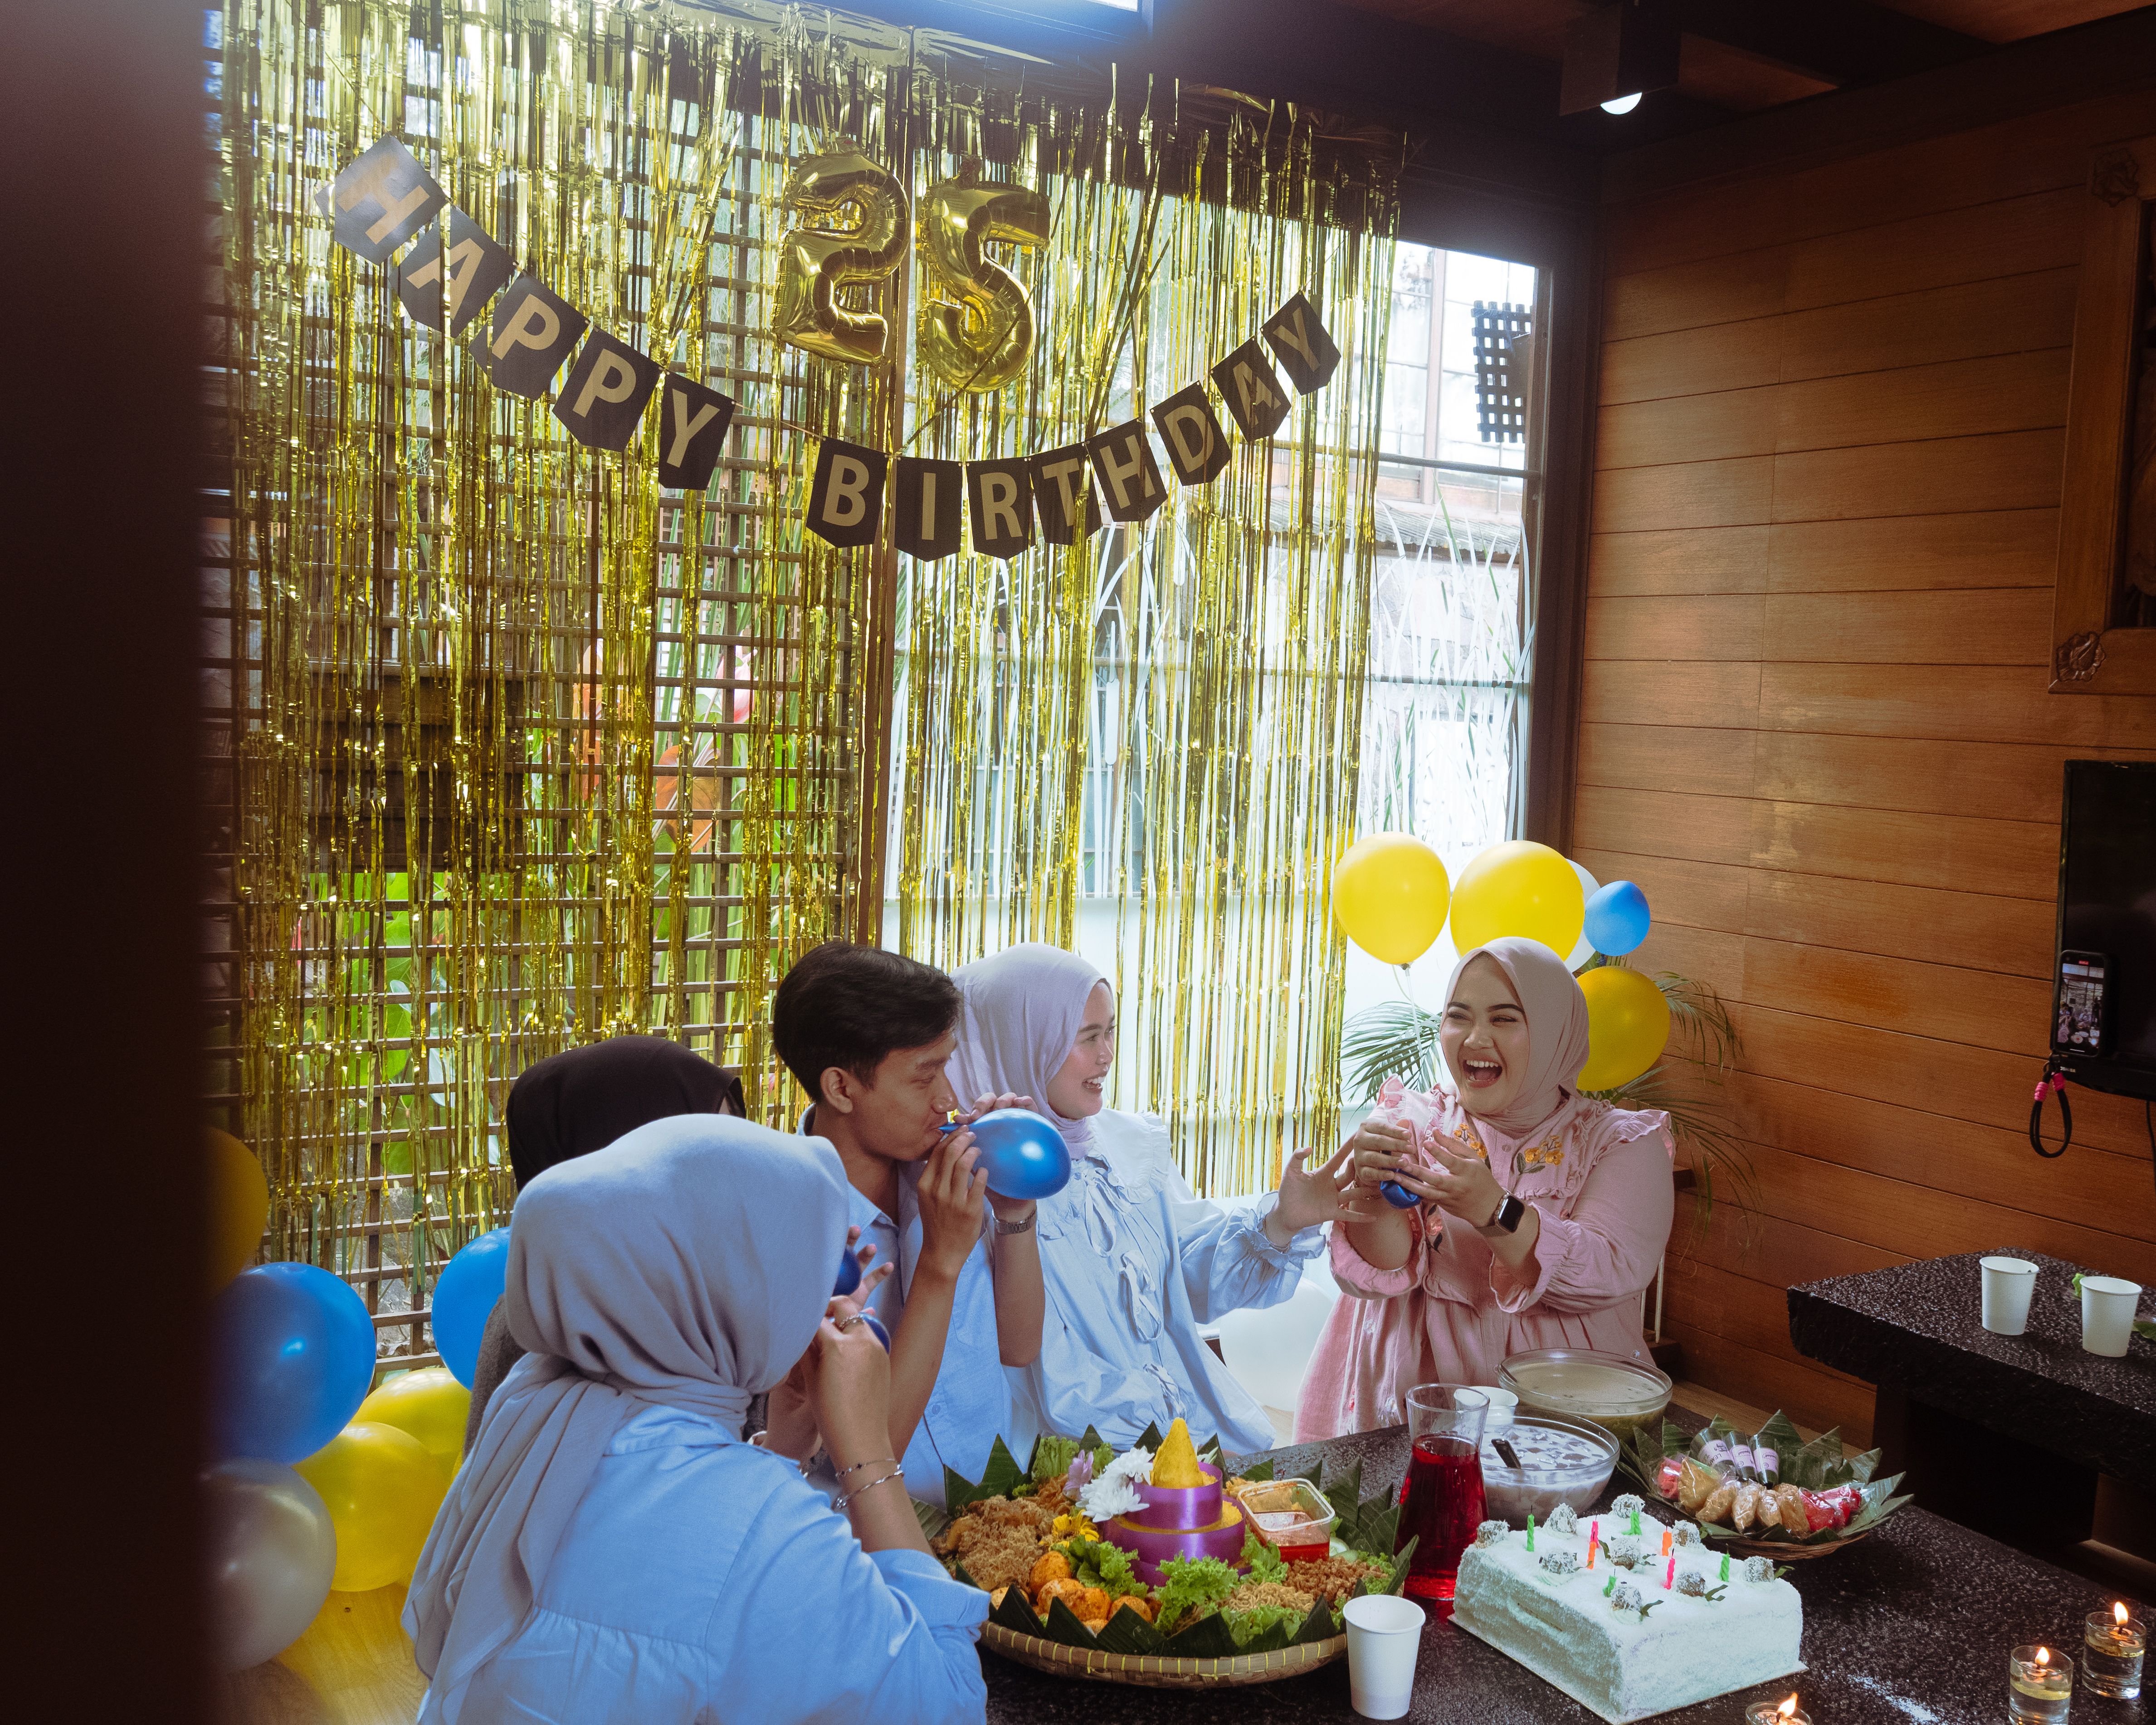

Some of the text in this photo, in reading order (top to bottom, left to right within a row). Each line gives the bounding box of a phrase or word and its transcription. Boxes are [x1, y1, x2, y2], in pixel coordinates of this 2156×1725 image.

[337, 152, 1321, 541] HAPPY BIRTHDAY
[772, 150, 1052, 395] 25
